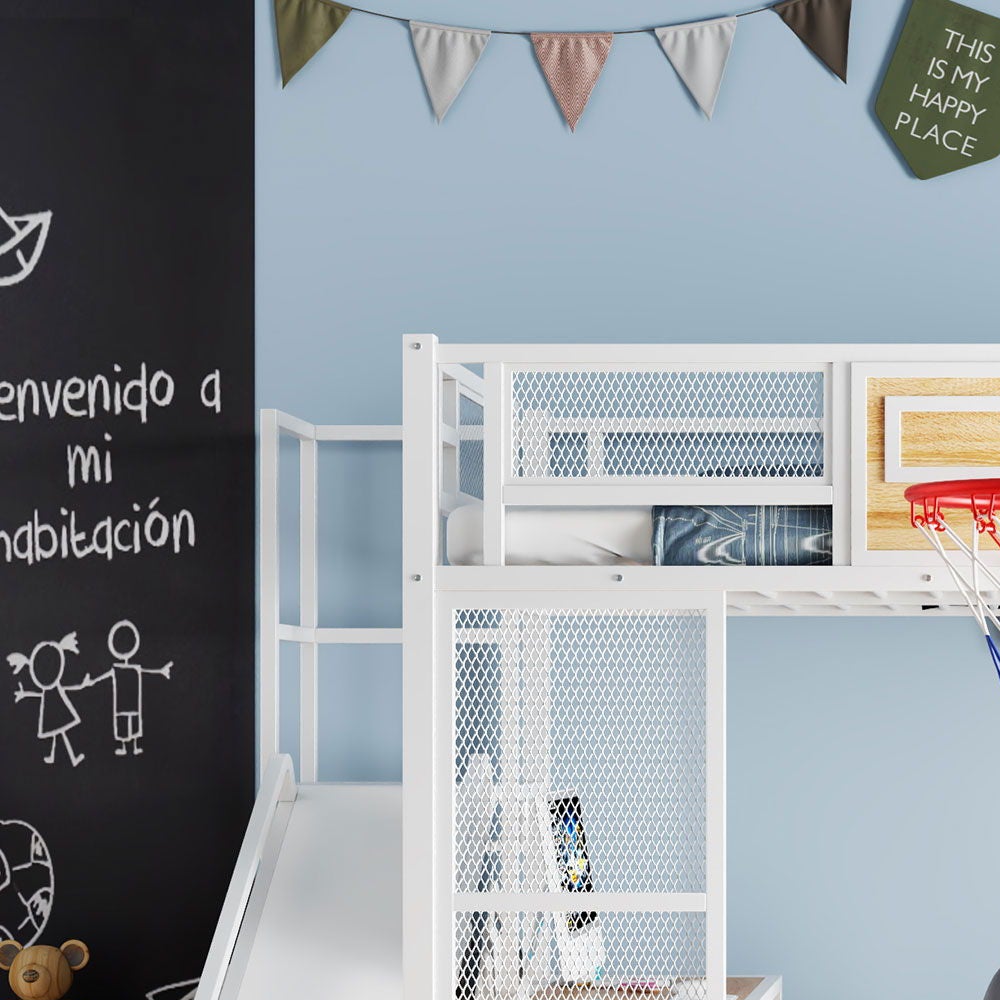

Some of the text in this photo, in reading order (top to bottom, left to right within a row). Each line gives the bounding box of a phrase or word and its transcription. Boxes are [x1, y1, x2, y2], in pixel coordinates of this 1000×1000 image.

[944, 27, 996, 64] THIS
[926, 56, 991, 94] IS MY
[908, 83, 988, 126] HAPPY
[894, 111, 979, 158] PLACE
[200, 368, 222, 414] a
[67, 432, 113, 488] mi
